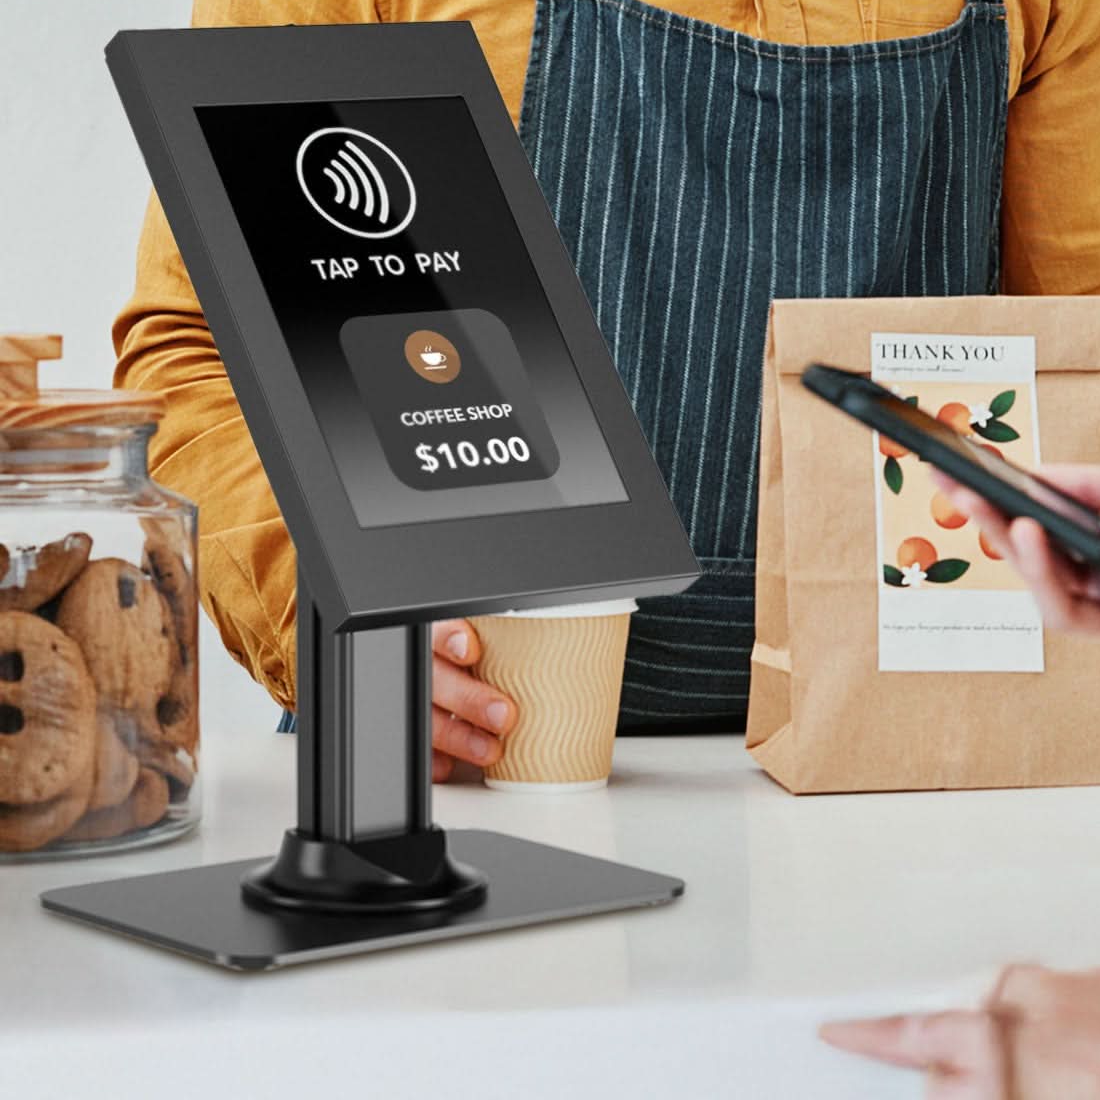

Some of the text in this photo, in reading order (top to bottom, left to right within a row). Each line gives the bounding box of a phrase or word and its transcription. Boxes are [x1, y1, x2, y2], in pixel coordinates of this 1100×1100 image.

[311, 251, 462, 281] TAP TO PAY
[876, 342, 1006, 363] THANK YOU
[399, 403, 514, 427] COFFEE SHOP
[414, 436, 531, 474] $10.00
